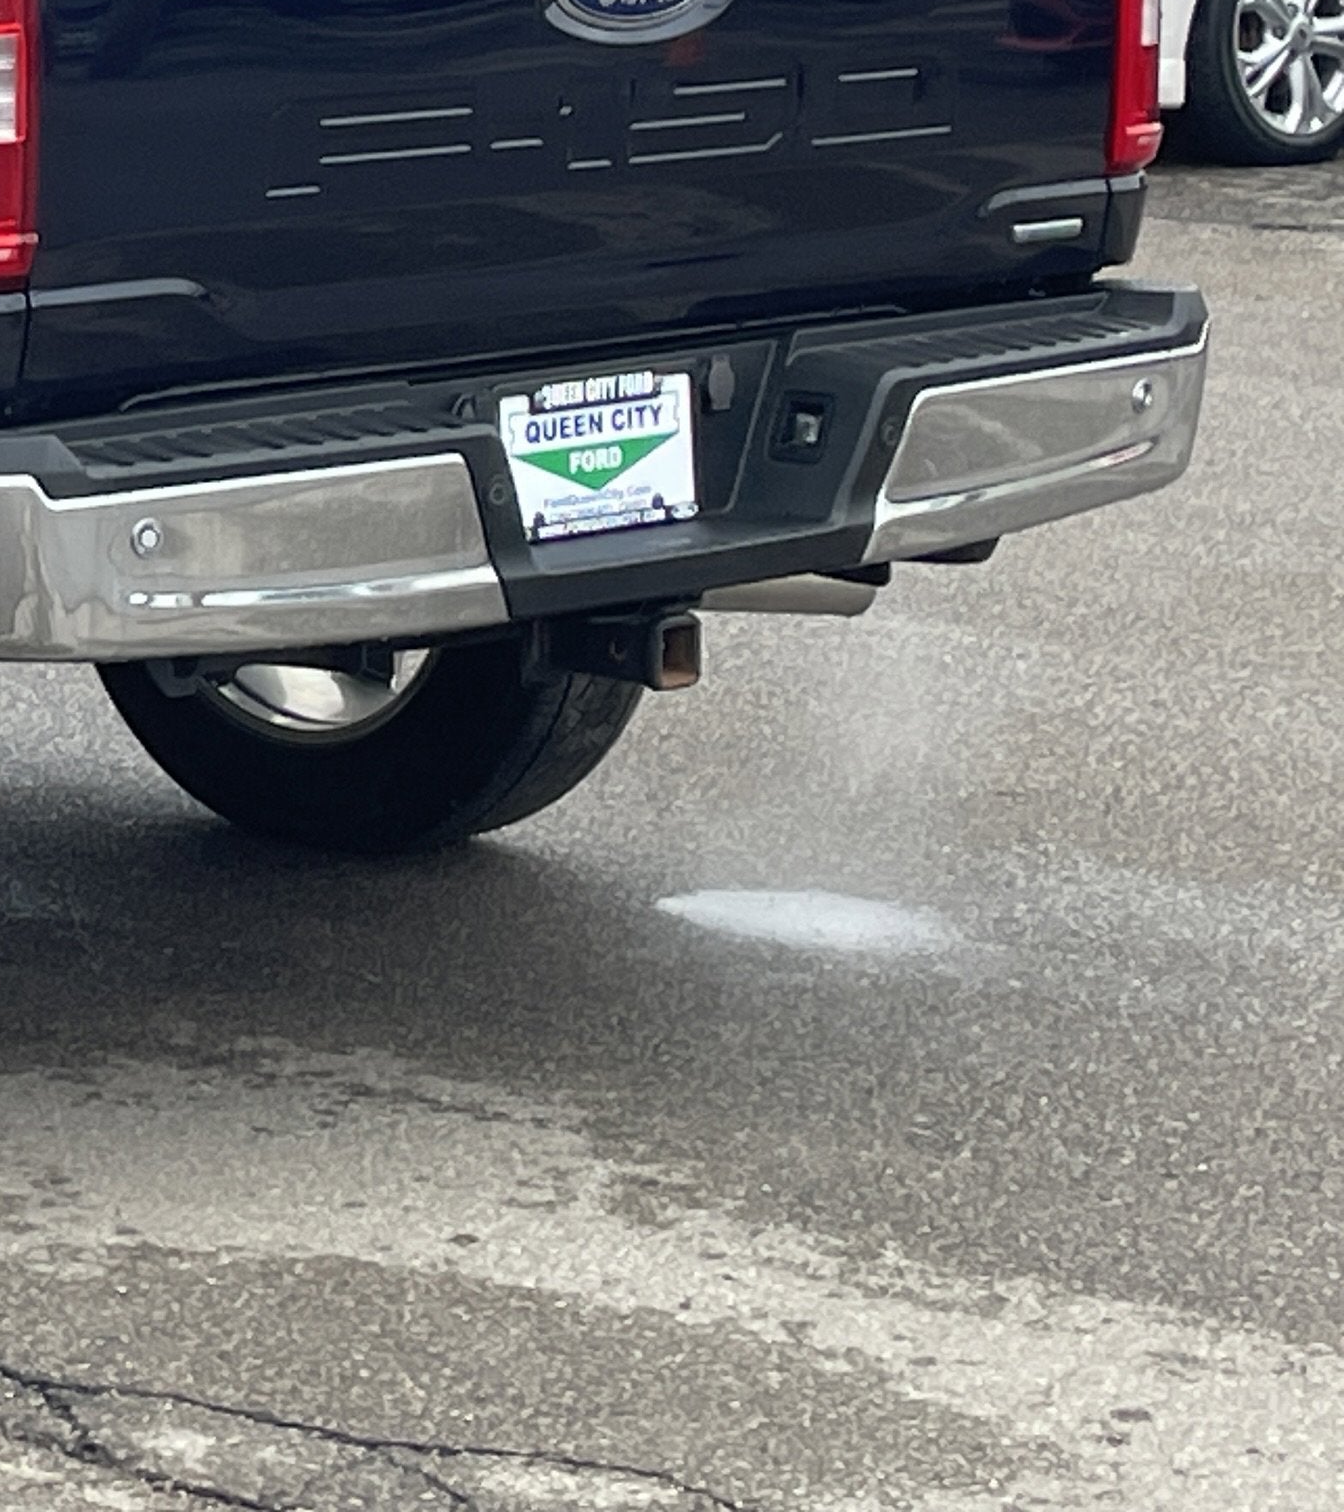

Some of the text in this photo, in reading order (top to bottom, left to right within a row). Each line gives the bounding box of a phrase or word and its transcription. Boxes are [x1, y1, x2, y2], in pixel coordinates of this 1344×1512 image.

[525, 403, 663, 444] QUEEN CITY
[568, 445, 624, 474] FORD
